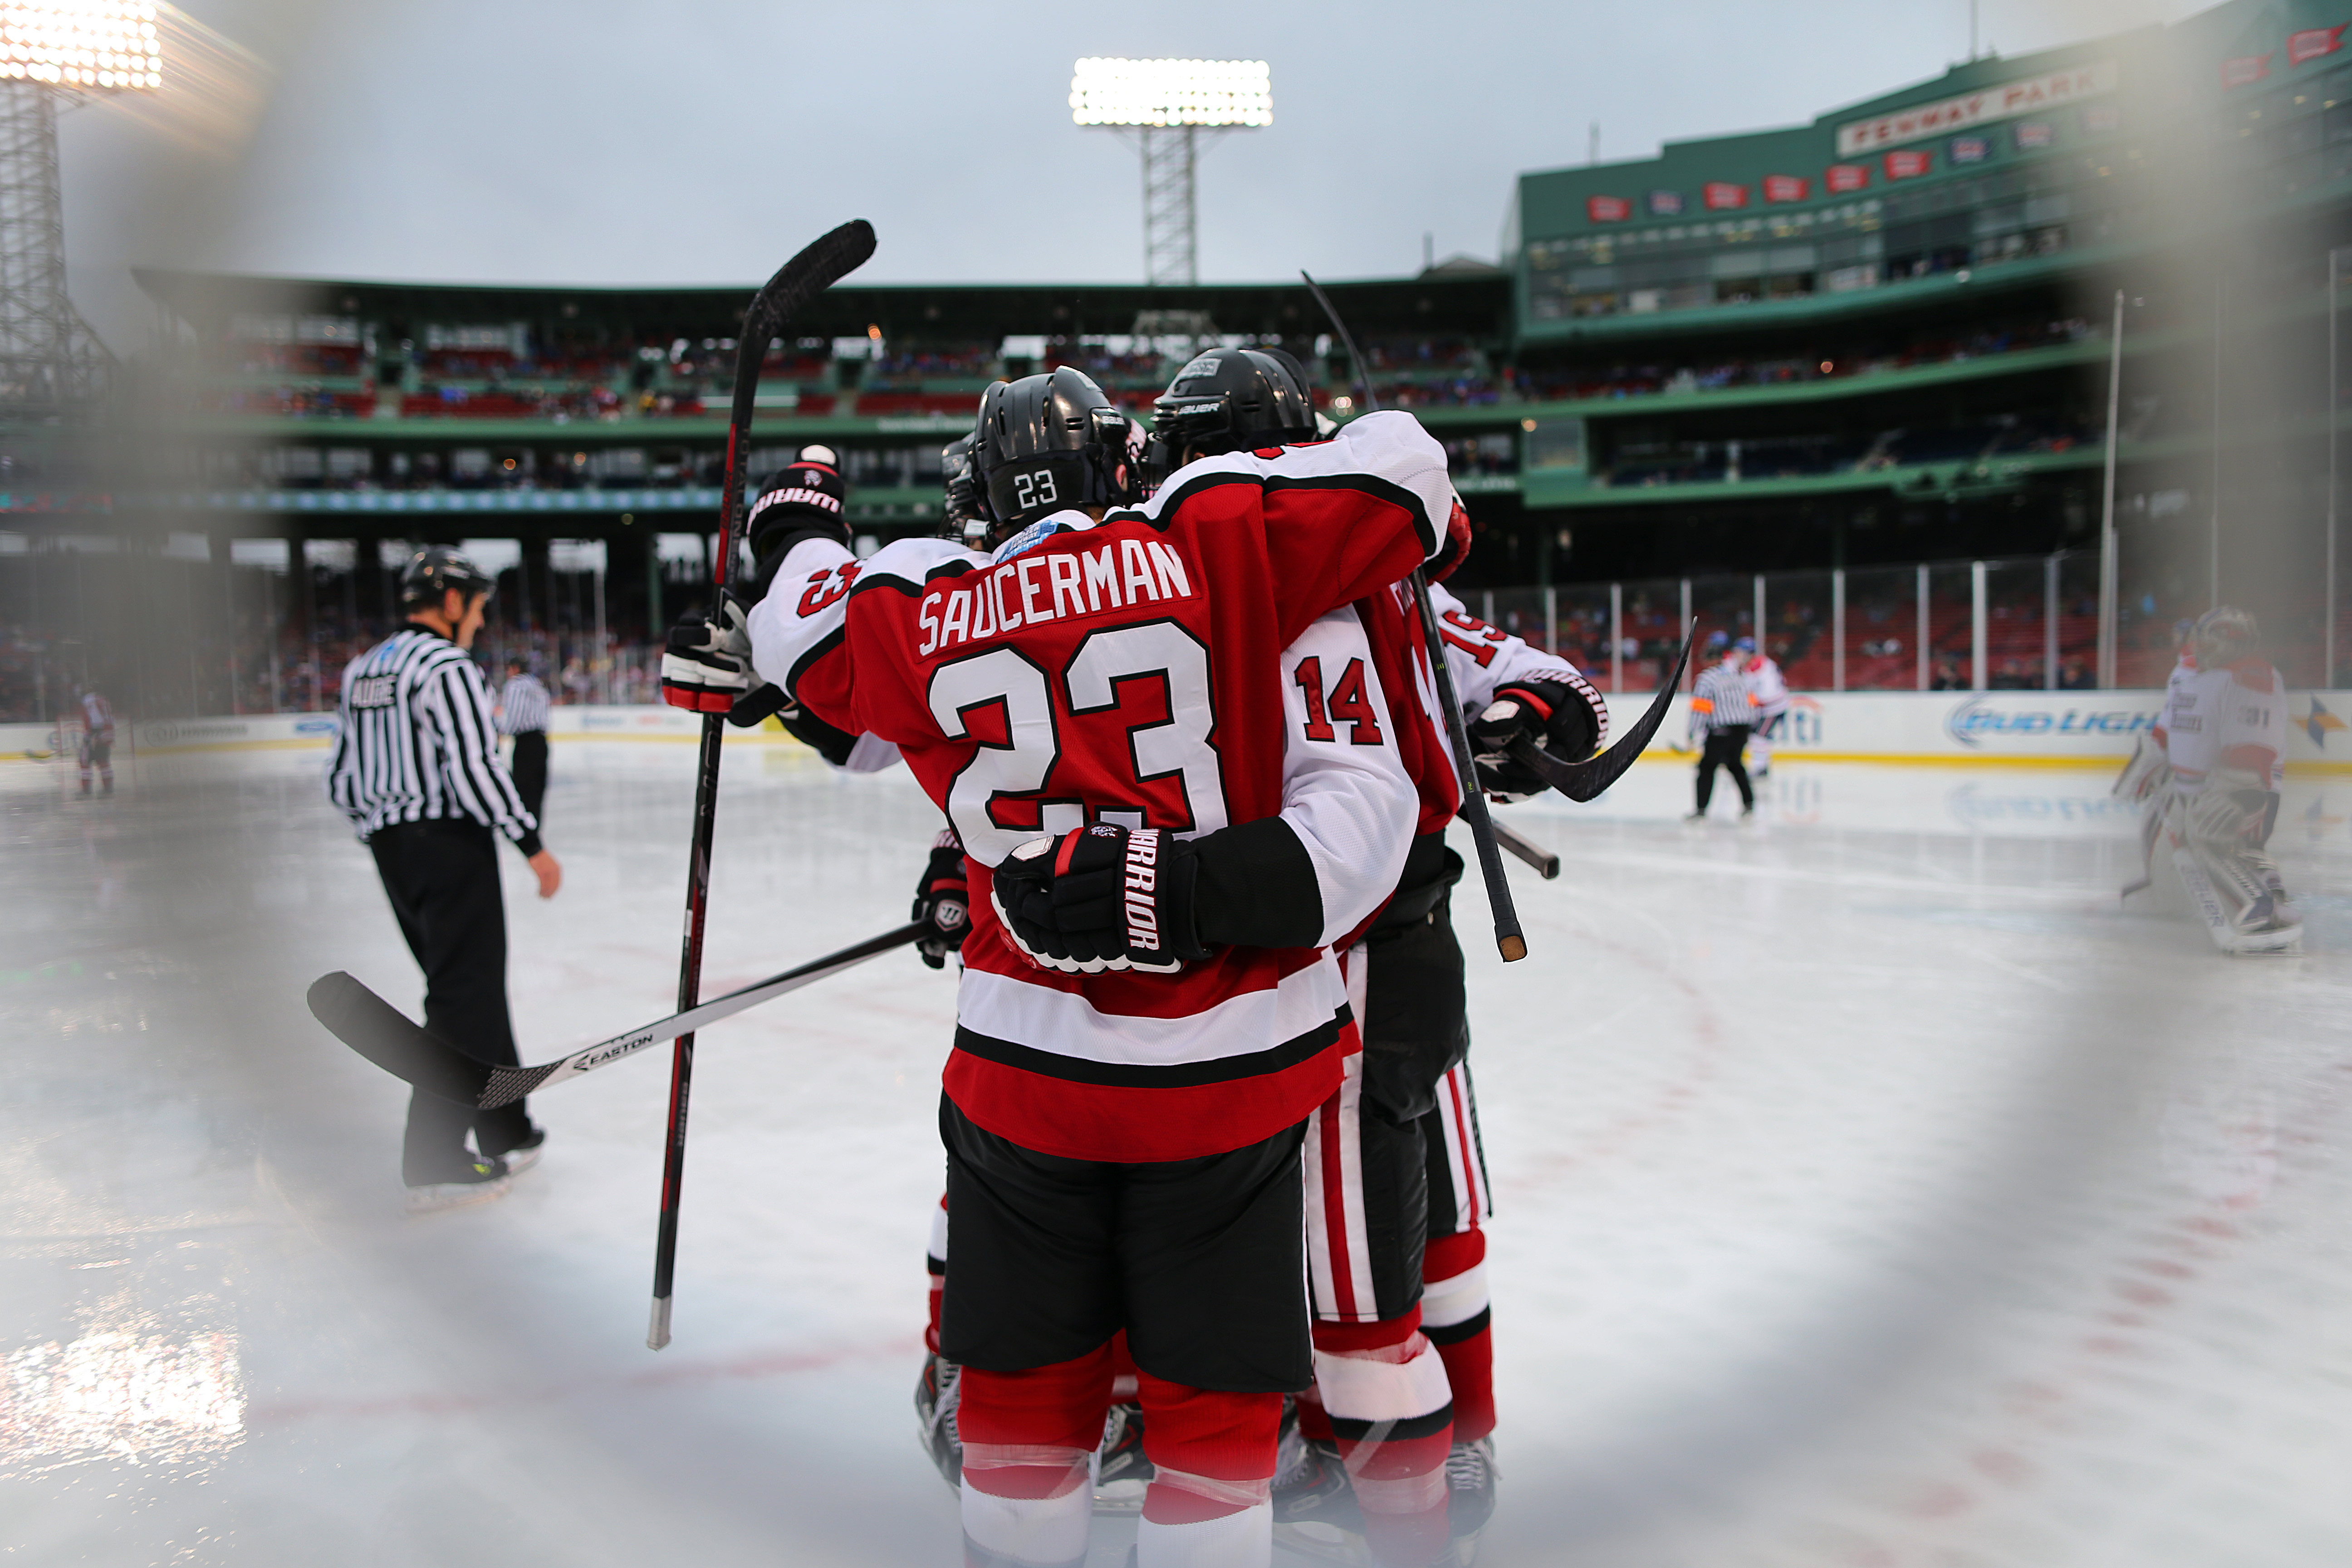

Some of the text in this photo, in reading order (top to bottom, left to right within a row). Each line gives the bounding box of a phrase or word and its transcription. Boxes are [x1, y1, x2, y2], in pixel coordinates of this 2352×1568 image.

[1853, 69, 2095, 143] FENWAY PARK
[1014, 469, 1058, 510] 23
[918, 539, 1192, 657] SAUCERMAN
[1294, 656, 1384, 745] 14
[2057, 706, 2163, 736] LIGH
[926, 616, 1231, 869] 23
[591, 1033, 653, 1065] EASTON
